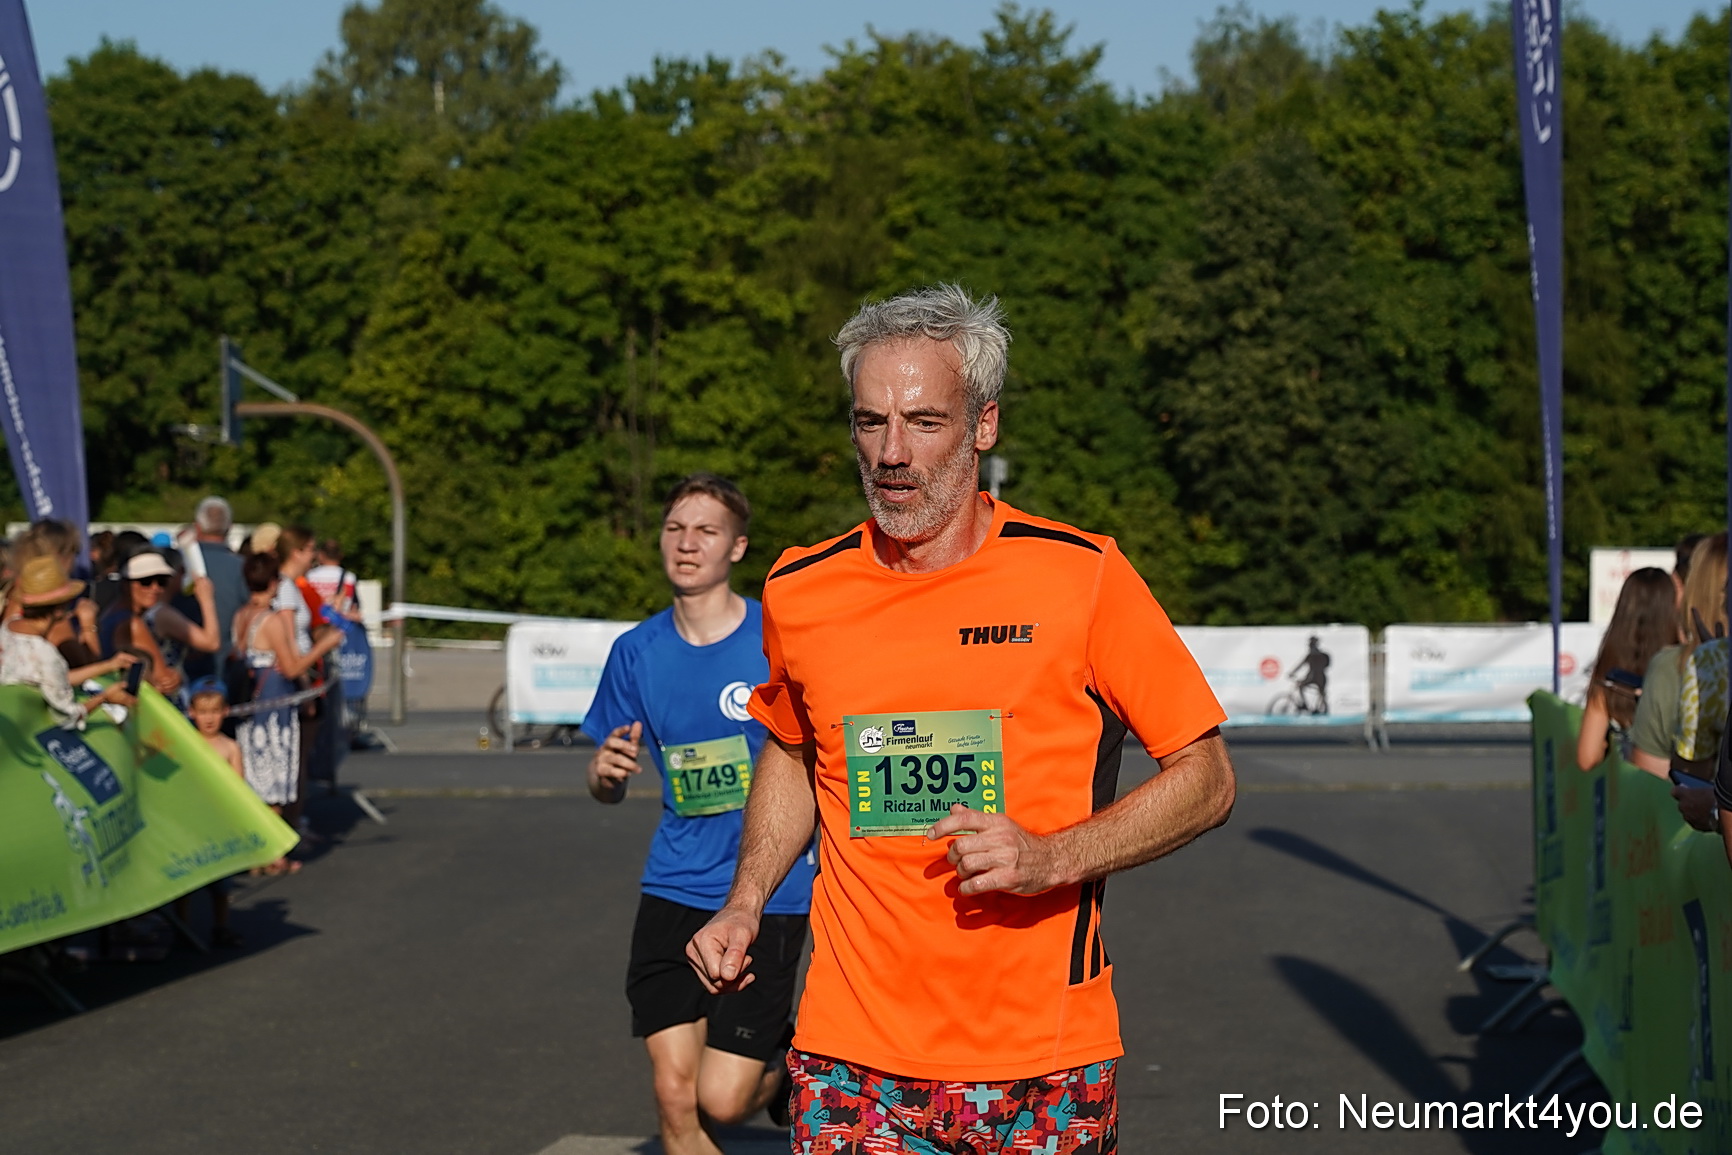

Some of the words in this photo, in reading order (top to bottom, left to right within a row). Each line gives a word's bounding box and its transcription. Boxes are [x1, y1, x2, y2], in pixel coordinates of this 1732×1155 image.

[959, 625, 1034, 645] THULE
[886, 733, 934, 746] Firmenlauf
[905, 742, 933, 750] neumarkt
[681, 763, 737, 792] 1749
[875, 754, 977, 795] 1395
[982, 759, 996, 814] 2022
[858, 771, 871, 812] RUN
[884, 799, 926, 813] Ridzal
